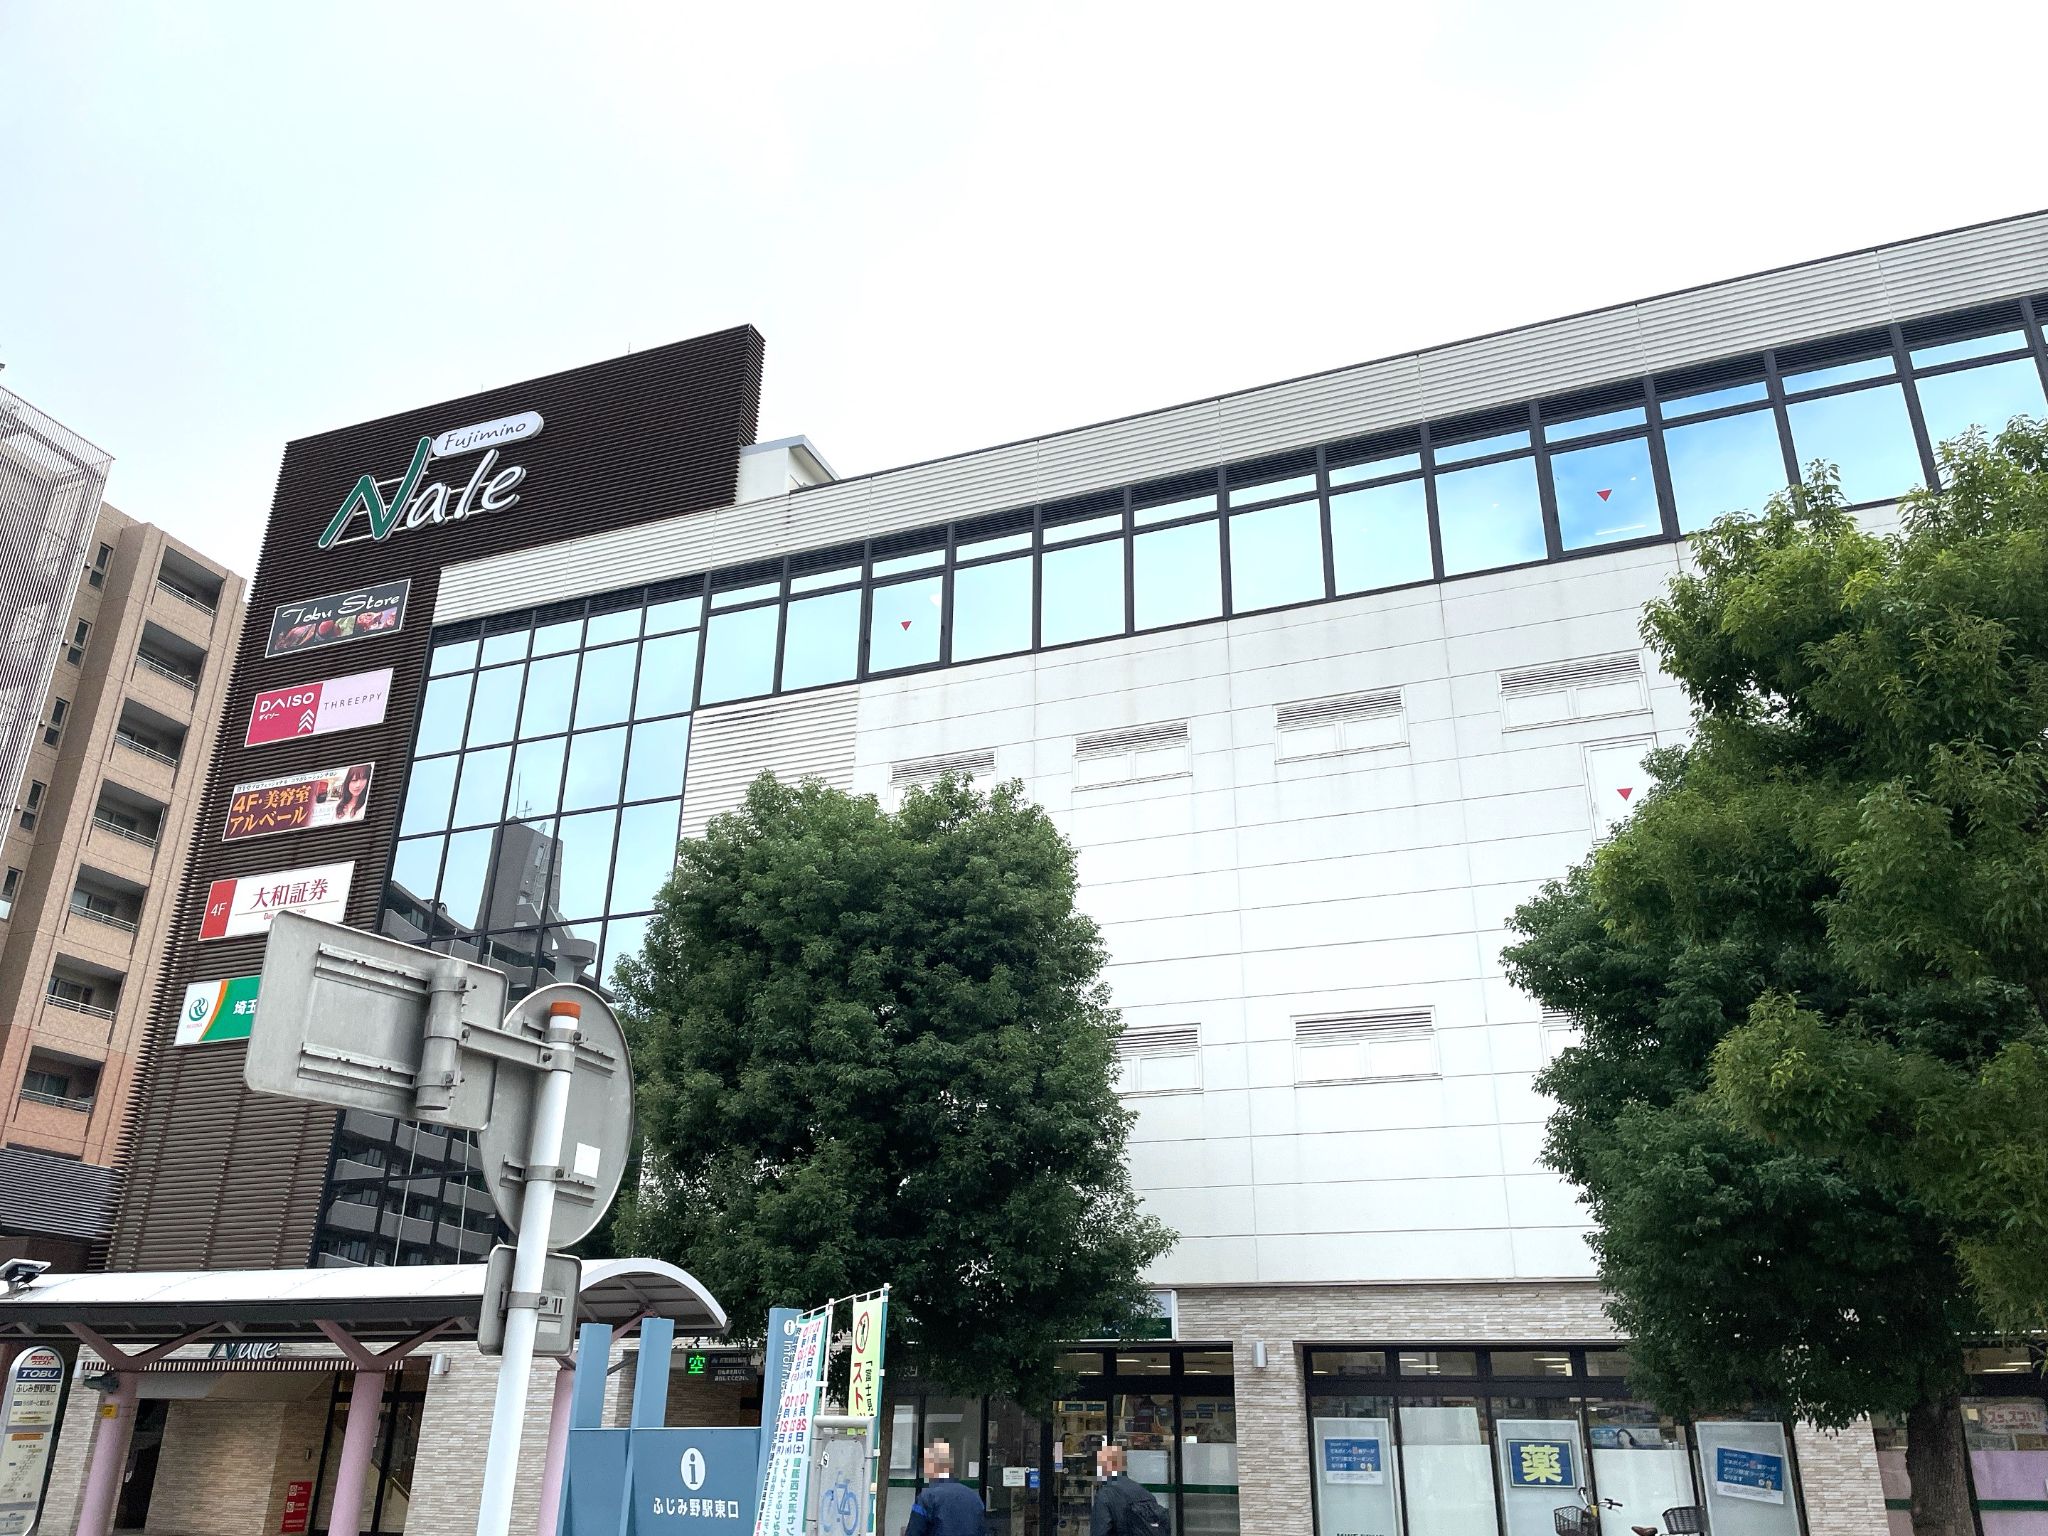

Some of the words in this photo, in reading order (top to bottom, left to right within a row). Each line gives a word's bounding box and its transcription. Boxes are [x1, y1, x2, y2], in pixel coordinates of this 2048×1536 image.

[444, 421, 526, 450] Fujimino
[318, 436, 527, 550] Nale
[282, 607, 333, 624] Tobu
[338, 595, 400, 615] Store
[259, 692, 315, 713] DAISO
[324, 693, 382, 711] THREEPPY
[230, 807, 309, 836] アルベール
[250, 878, 329, 910] 大和証券
[211, 902, 227, 917] 4F
[22, 1369, 58, 1378] TOBU
[688, 1355, 706, 1374] 空
[1520, 1444, 1563, 1483] 薬
[654, 1497, 739, 1518] ふじみ野駅東口
